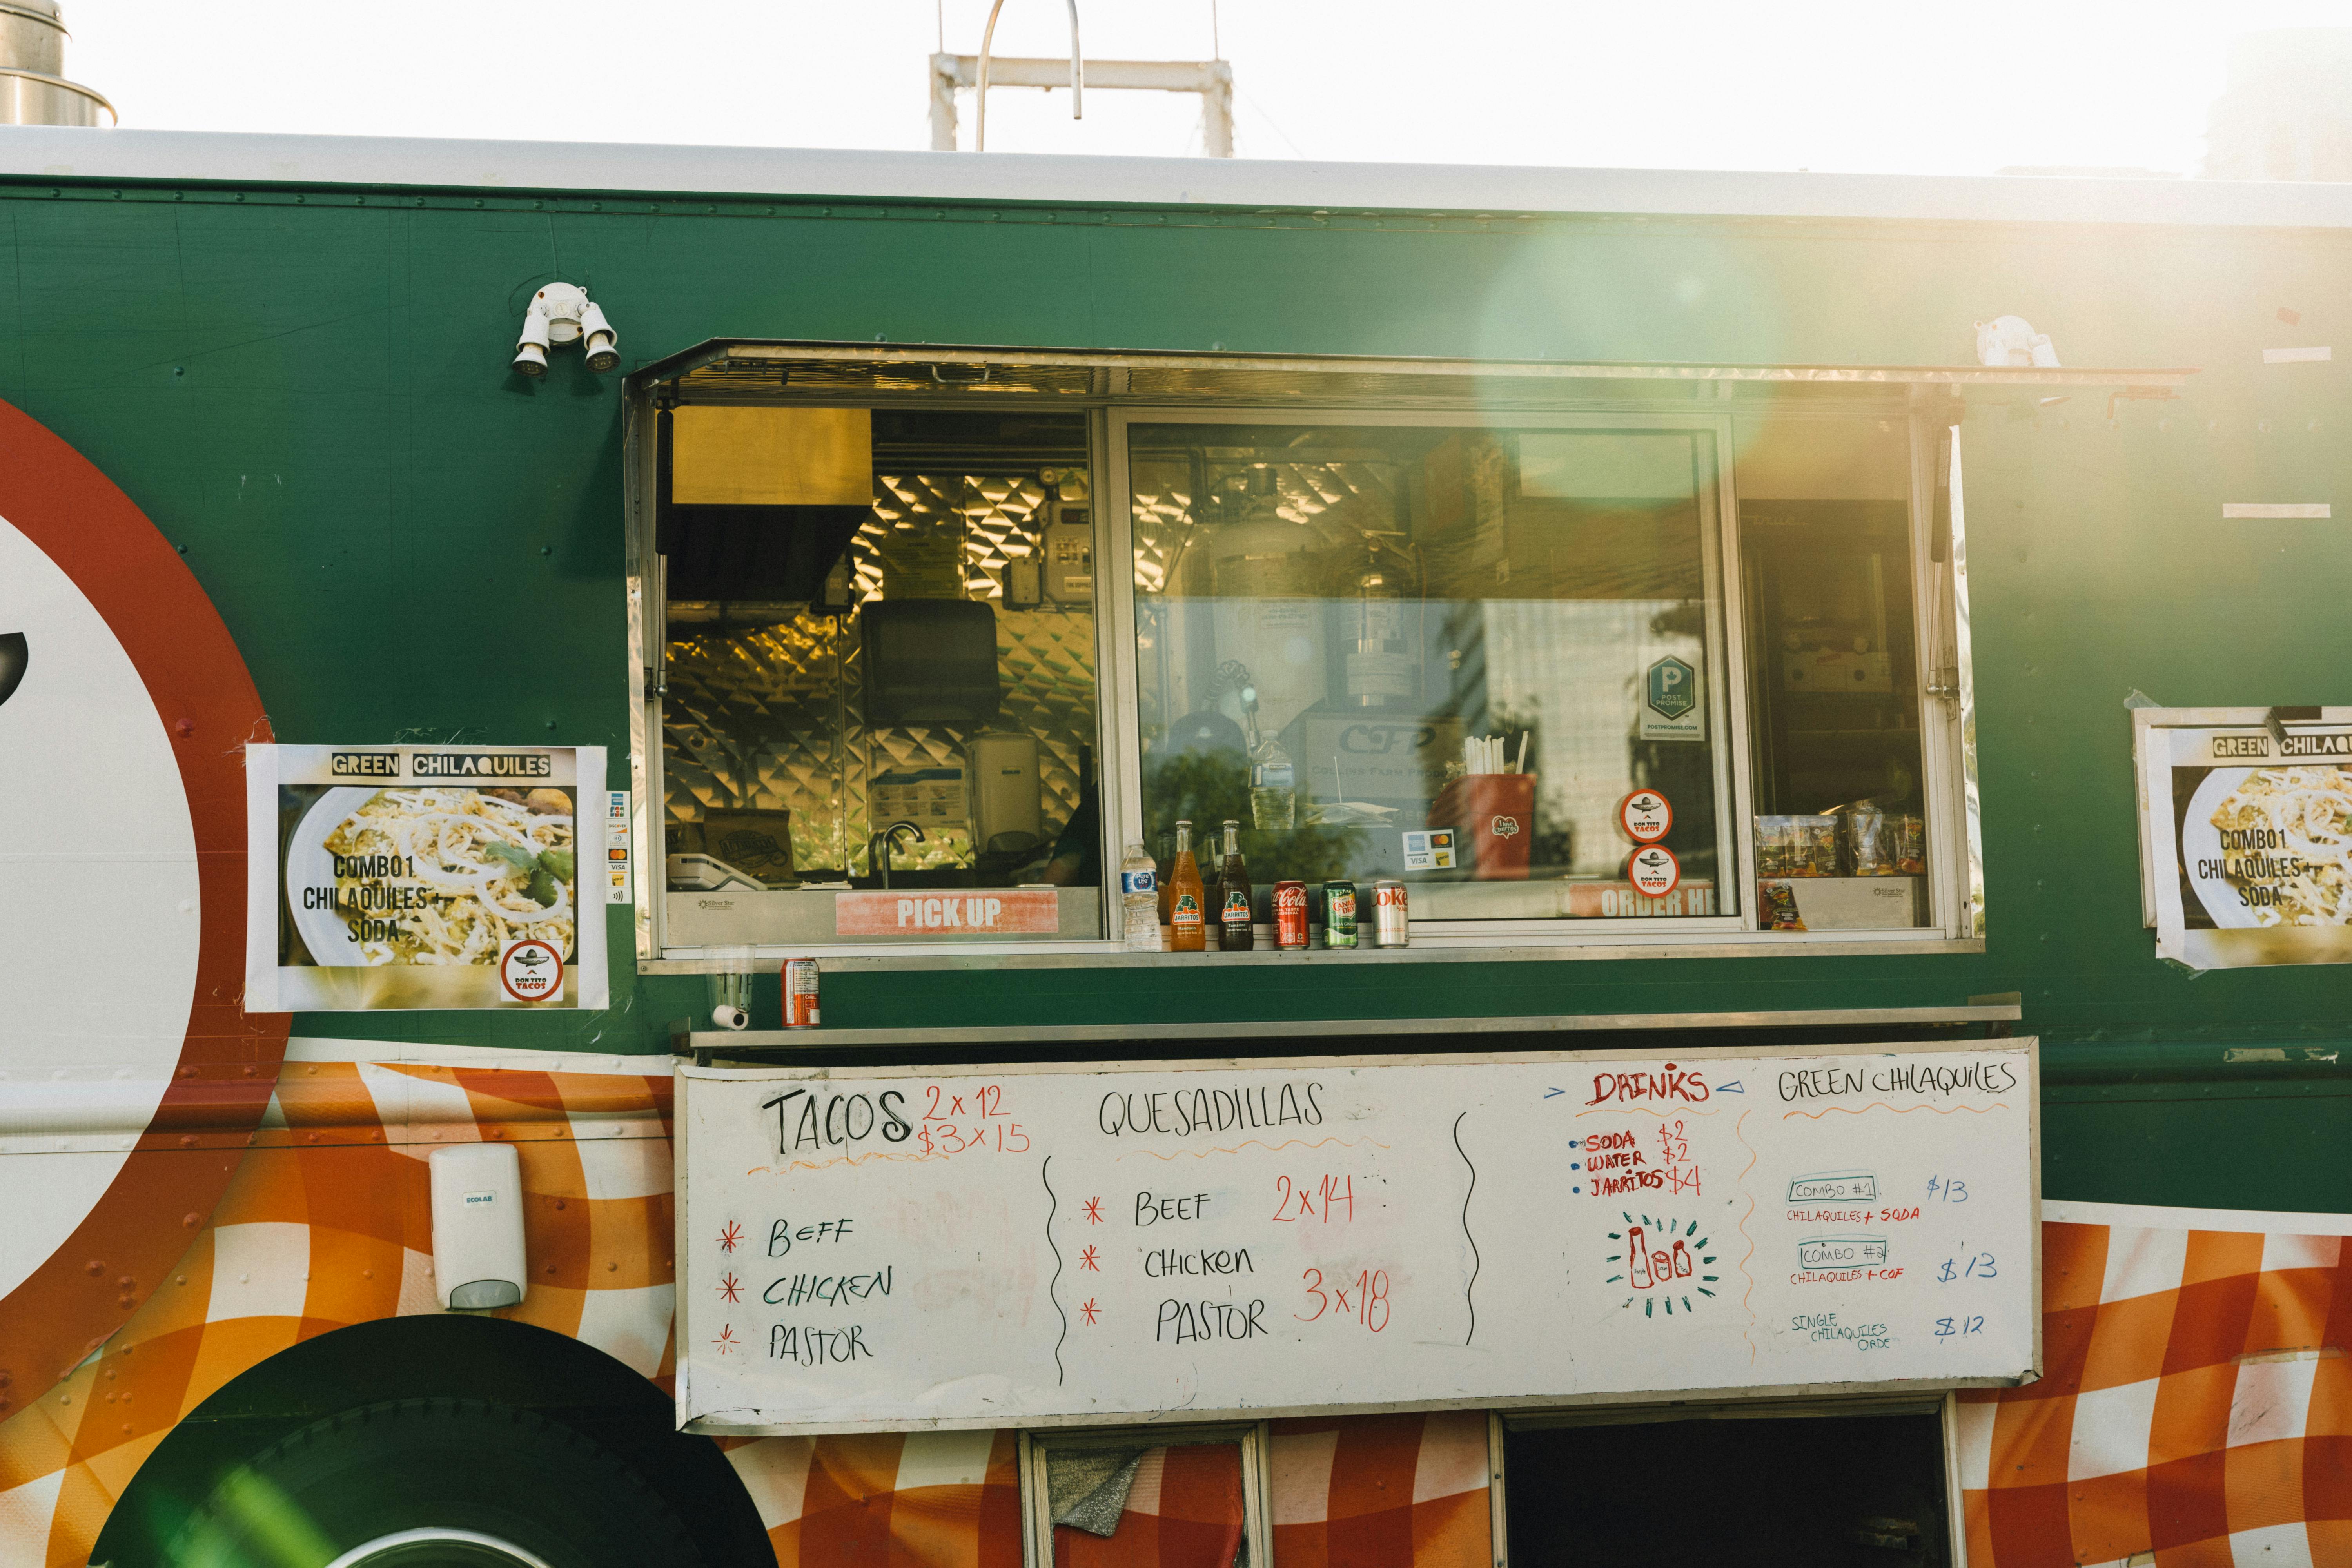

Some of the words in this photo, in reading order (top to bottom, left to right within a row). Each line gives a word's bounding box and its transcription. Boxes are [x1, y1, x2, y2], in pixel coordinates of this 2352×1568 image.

[2214, 738, 2268, 755] GREEN
[2281, 736, 2352, 754] CHILAQ
[332, 755, 399, 774] GREEN
[413, 756, 550, 775] CHILAQUILES
[2198, 857, 2301, 879] CHILAQUILES
[303, 887, 428, 911] CHILAQUILES
[1370, 887, 1408, 907] Coke
[1602, 889, 1682, 917] ORDER
[2238, 886, 2283, 906] SODA
[898, 899, 960, 928] PICK
[968, 898, 1001, 927] UP
[1342, 906, 1355, 914] DRY
[347, 919, 399, 942] SODA
[717, 973, 753, 994] TIP
[1585, 1063, 1709, 1105] DRINKS
[1779, 1067, 1864, 1101] GREEN
[1872, 1062, 2016, 1096] CHILAQUILES
[1099, 1082, 1323, 1137] QUESADILLAS
[762, 1089, 913, 1154] TACOS
[1585, 1129, 1635, 1152] SODA
[1587, 1151, 1647, 1172] WATER
[1591, 1169, 1664, 1197] JARRITOS
[1666, 1165, 1701, 1196] $4
[1796, 1183, 1844, 1198] COMBO
[1135, 1191, 1211, 1226] BEEF
[1787, 1210, 1861, 1223] CHILAQUILES
[1880, 1207, 1920, 1221] SODA
[1804, 1248, 1854, 1263] COMBO
[763, 1265, 892, 1307] CHICKEN
[1790, 1270, 1862, 1285] CHILAQUILES
[1880, 1268, 1904, 1280] COF
[1156, 1298, 1269, 1344] PASTOR
[1792, 1313, 1837, 1330] SINGLE
[1811, 1323, 1887, 1342] CHILAQUILES
[770, 1324, 874, 1367] PASTOR
